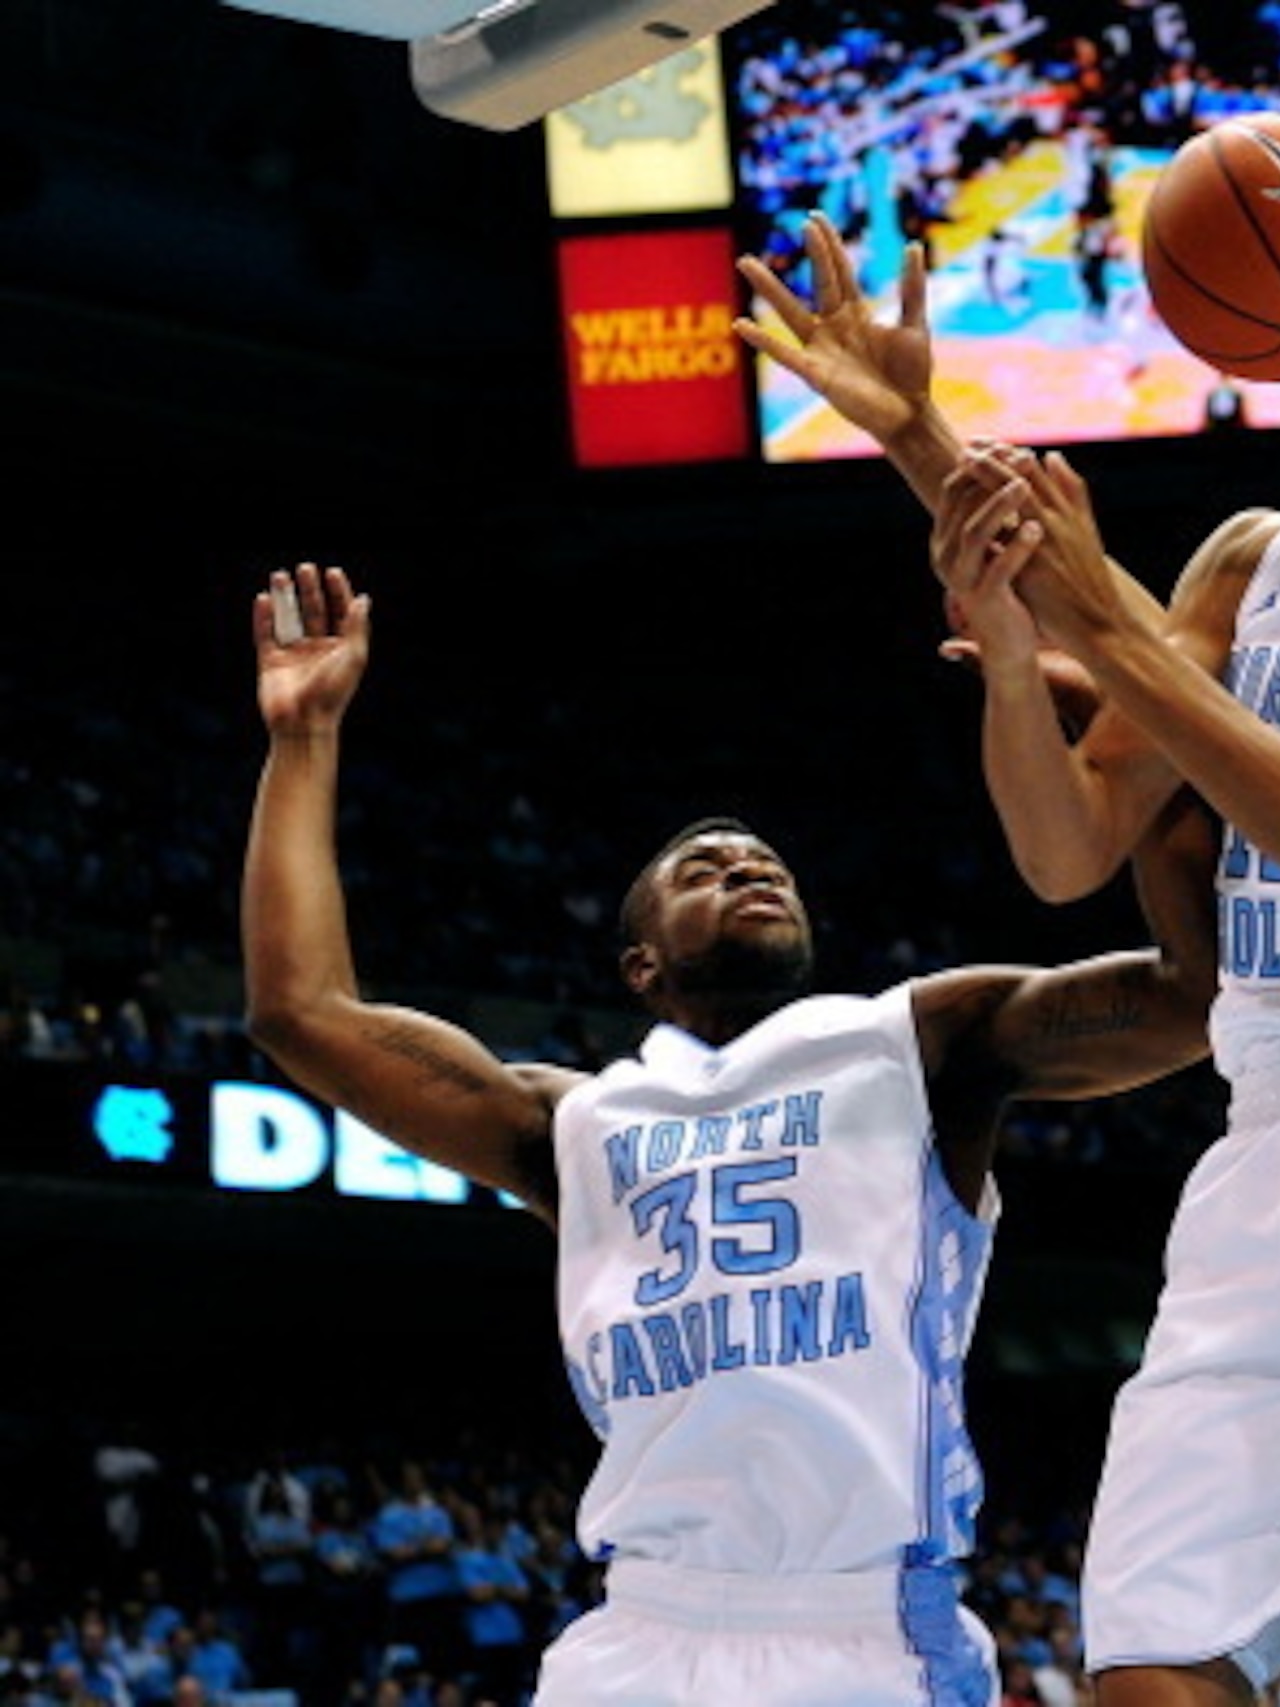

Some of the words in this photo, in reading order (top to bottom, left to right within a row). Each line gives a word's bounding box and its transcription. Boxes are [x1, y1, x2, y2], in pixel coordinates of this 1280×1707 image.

[571, 303, 732, 347] WELLS
[579, 342, 736, 386] FARGO
[604, 1091, 823, 1204] NORTH
[629, 1155, 801, 1305] 35
[586, 1272, 870, 1405] CAROLINA
